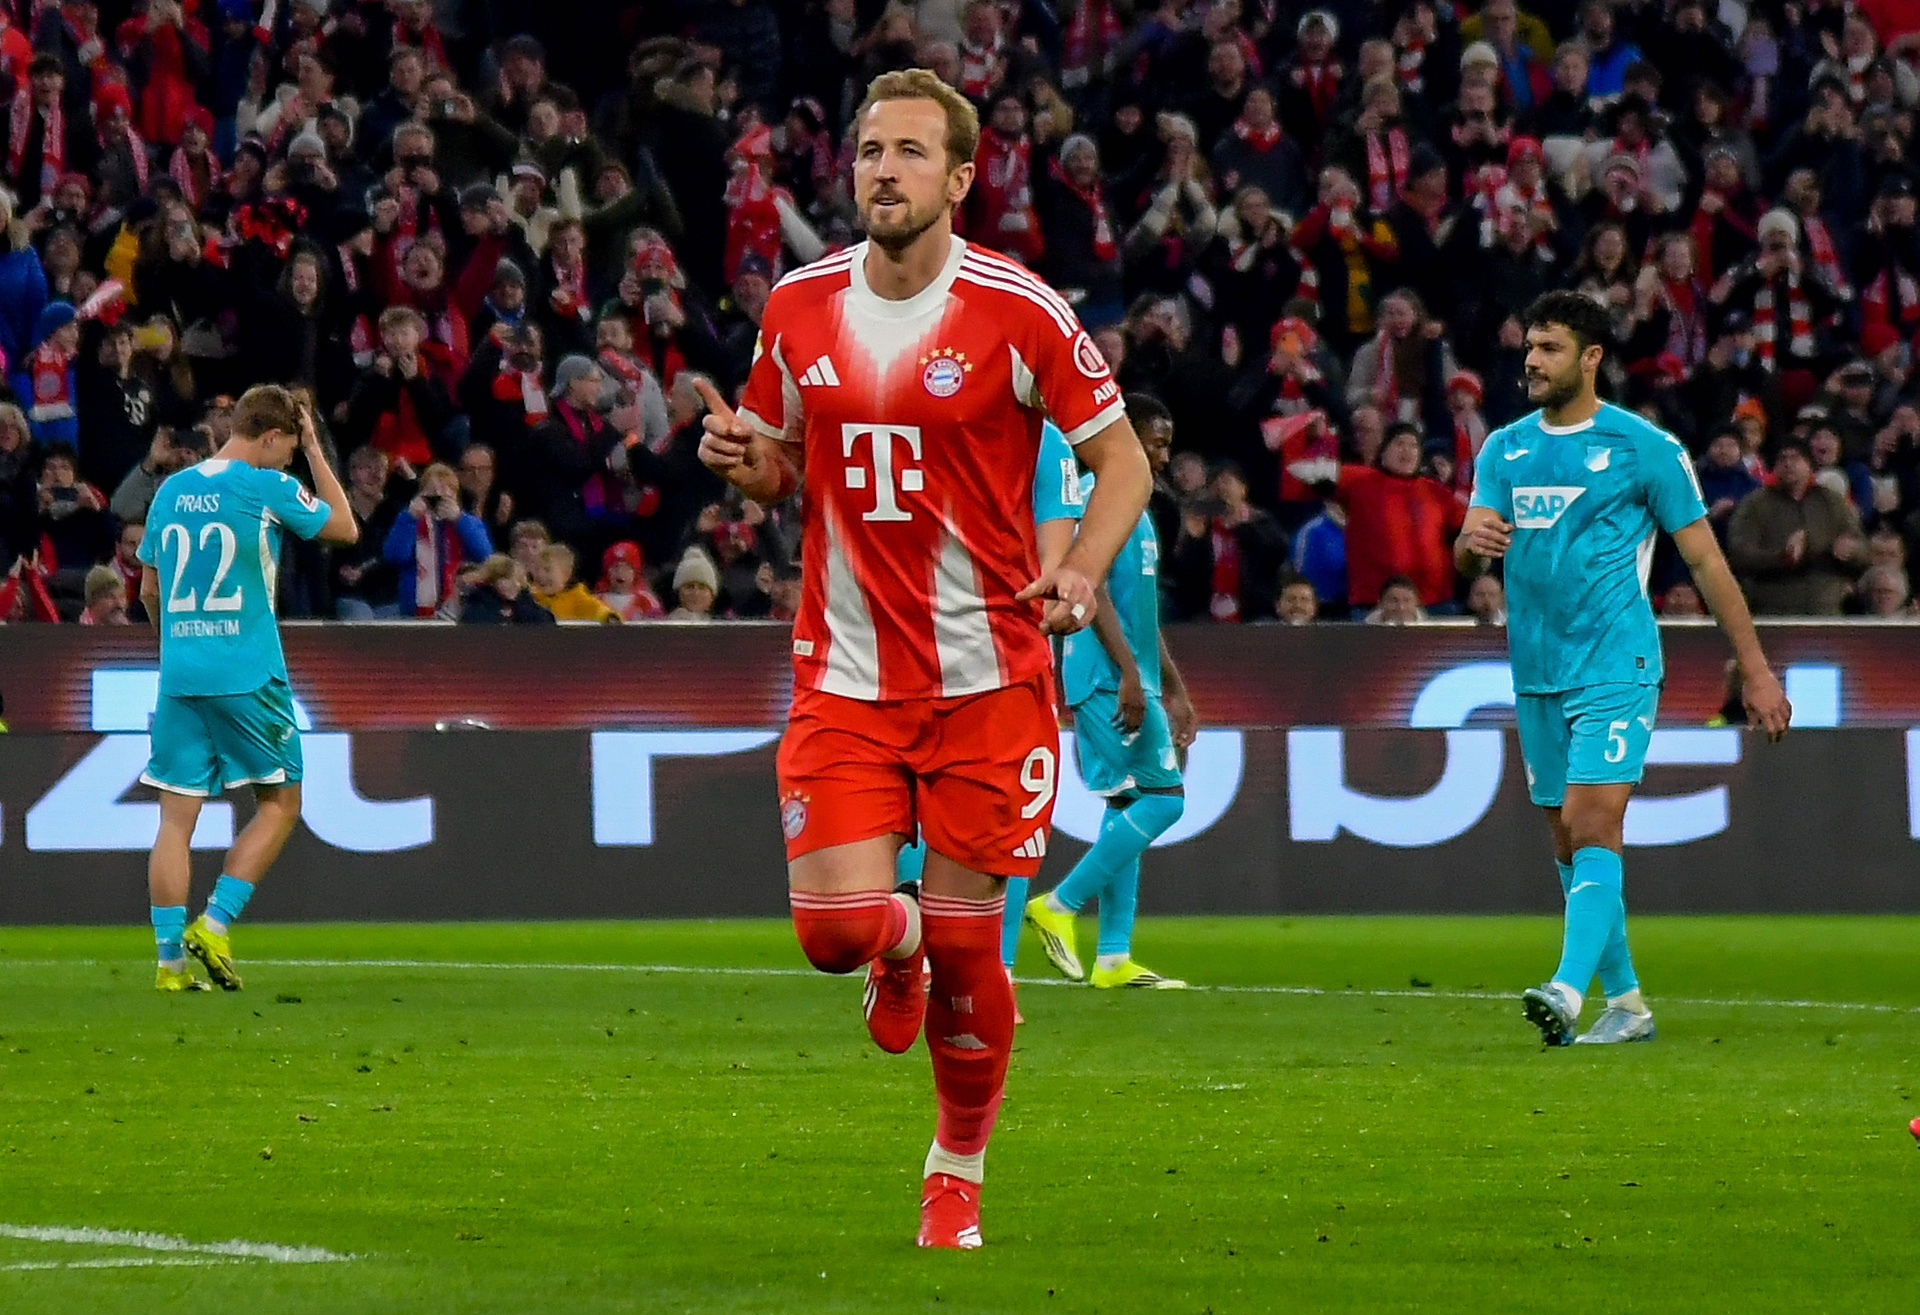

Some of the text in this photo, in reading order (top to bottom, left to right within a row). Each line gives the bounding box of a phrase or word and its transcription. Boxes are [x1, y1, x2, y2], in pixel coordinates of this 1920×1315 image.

[841, 422, 923, 522] T
[174, 493, 221, 513] PRASS
[1514, 494, 1566, 520] SAP
[161, 522, 243, 614] 22
[170, 619, 240, 638] HOFFENHEIM
[1604, 720, 1629, 763] 5
[1020, 746, 1055, 819] 9
